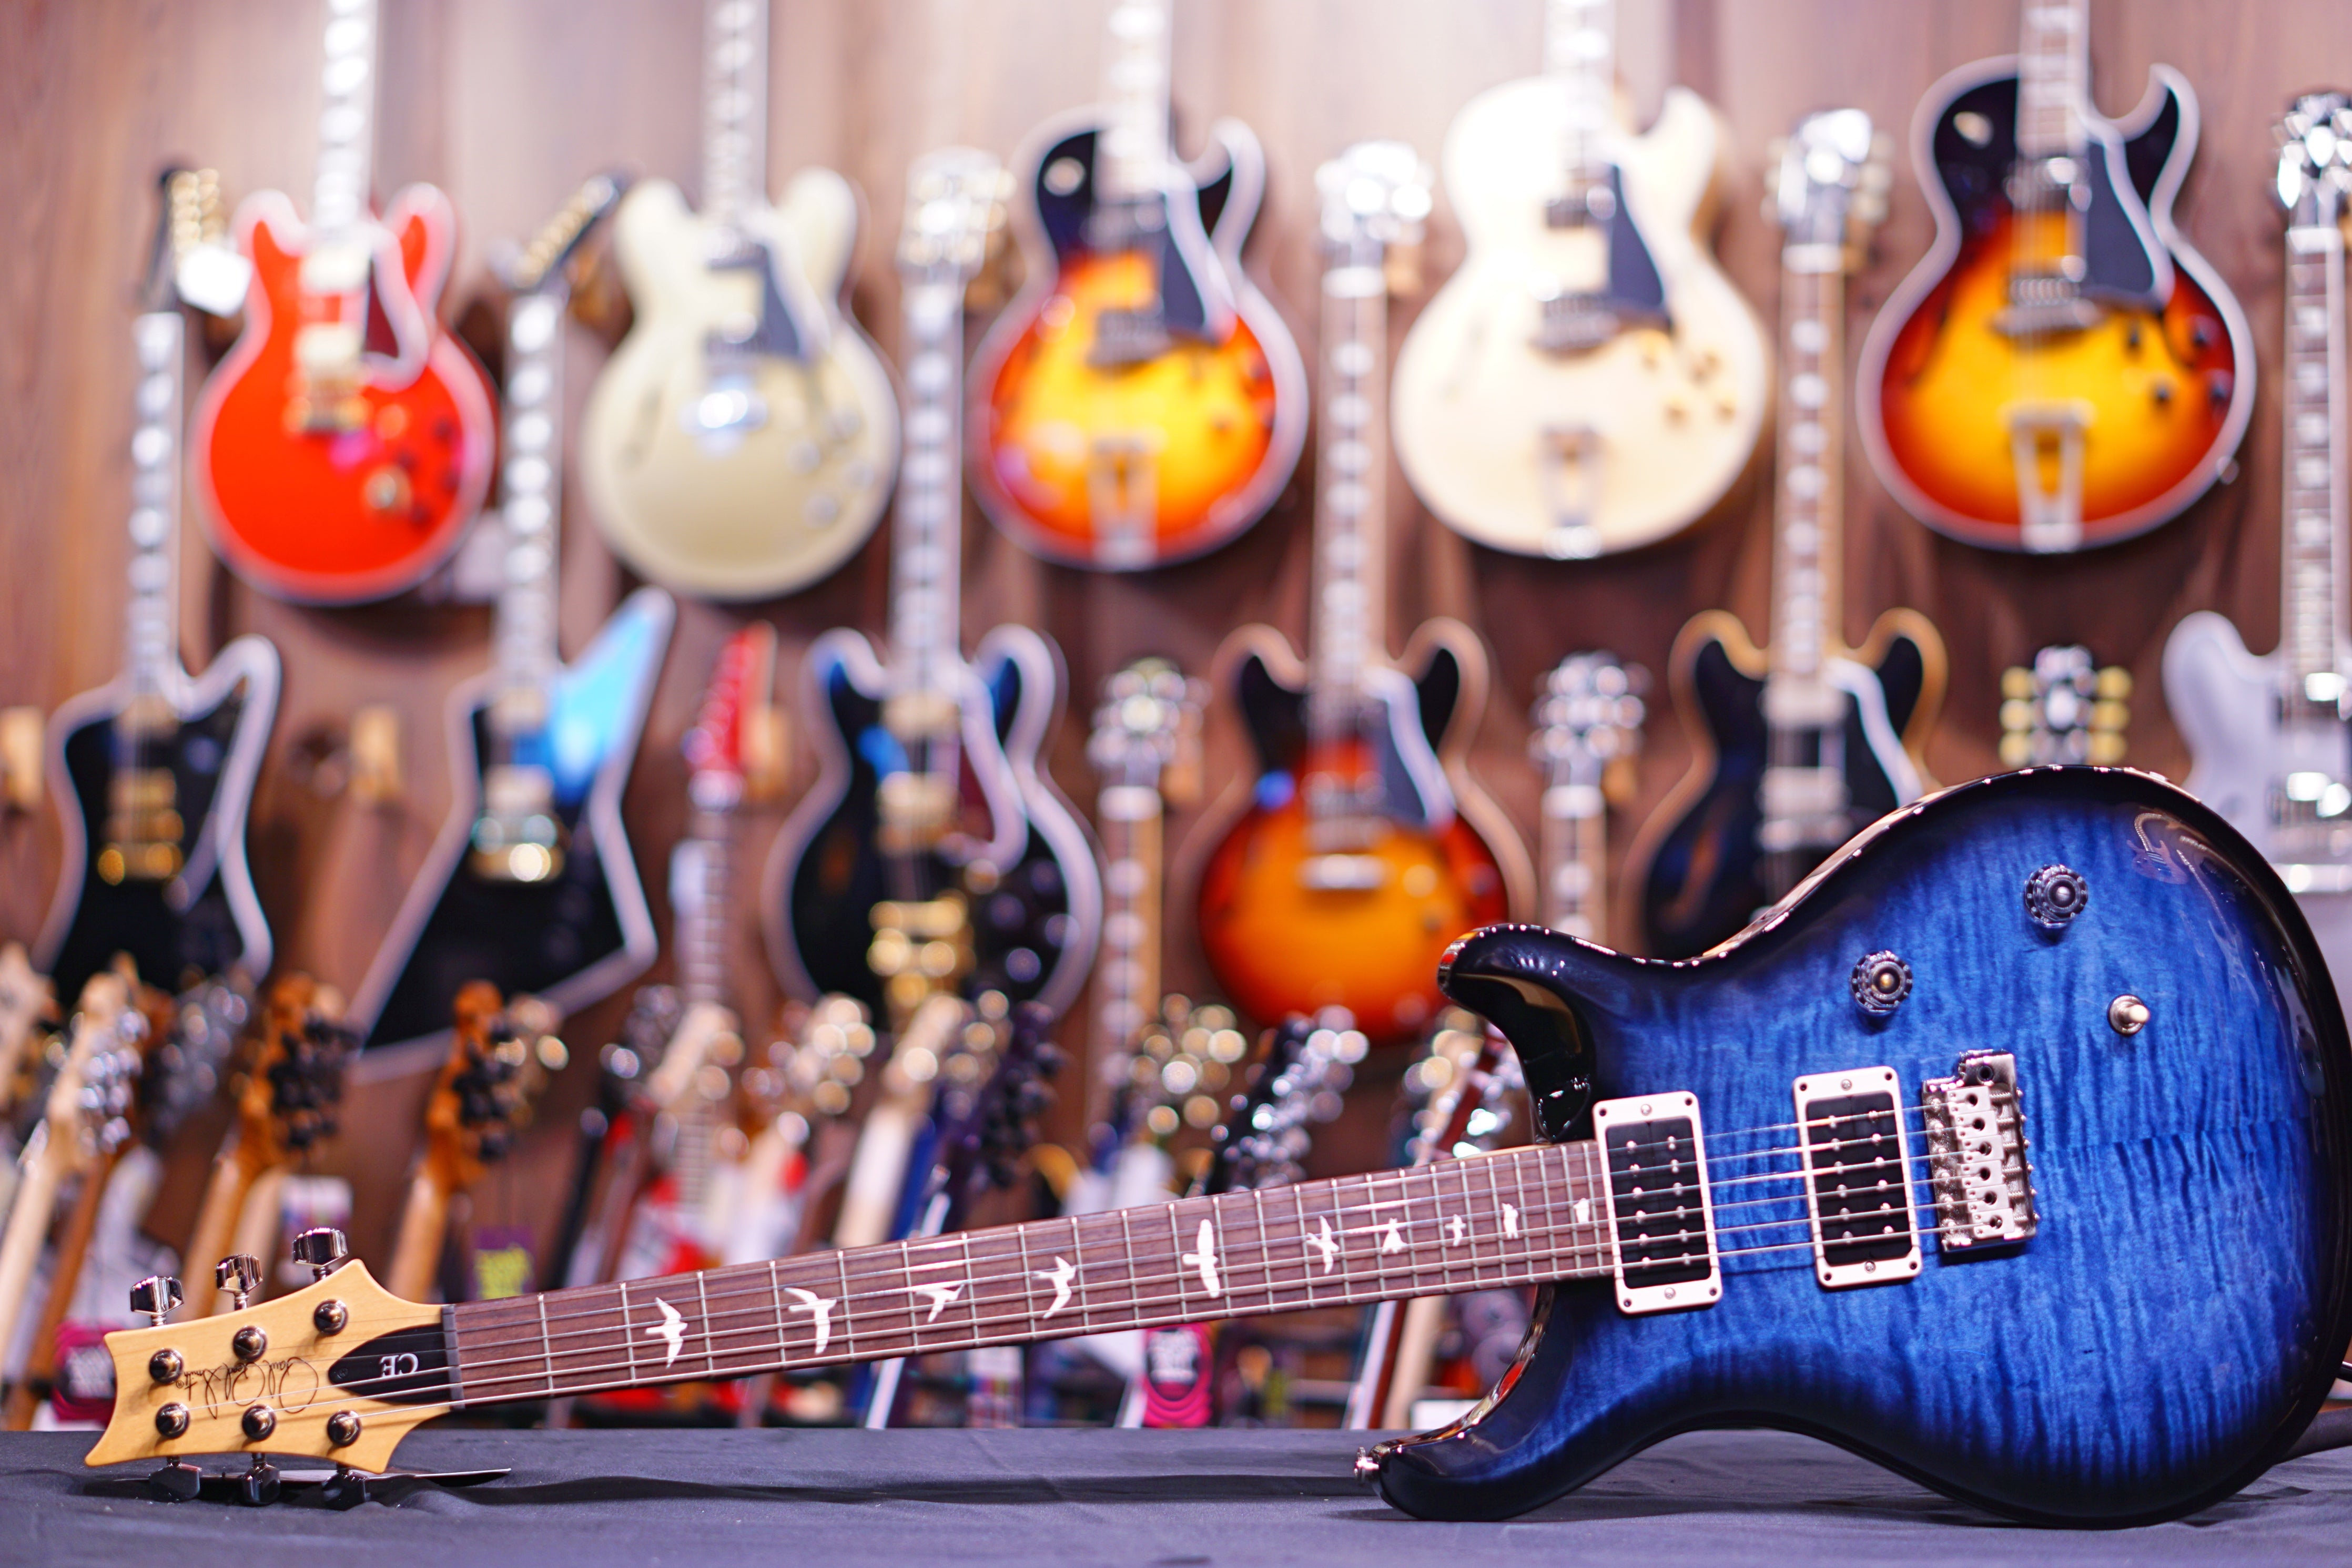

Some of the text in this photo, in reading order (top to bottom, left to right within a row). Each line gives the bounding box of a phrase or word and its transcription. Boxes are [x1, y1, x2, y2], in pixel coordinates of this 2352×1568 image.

[223, 1362, 266, 1407] Reed
[262, 1357, 319, 1414] Paul
[379, 1353, 419, 1379] CE
